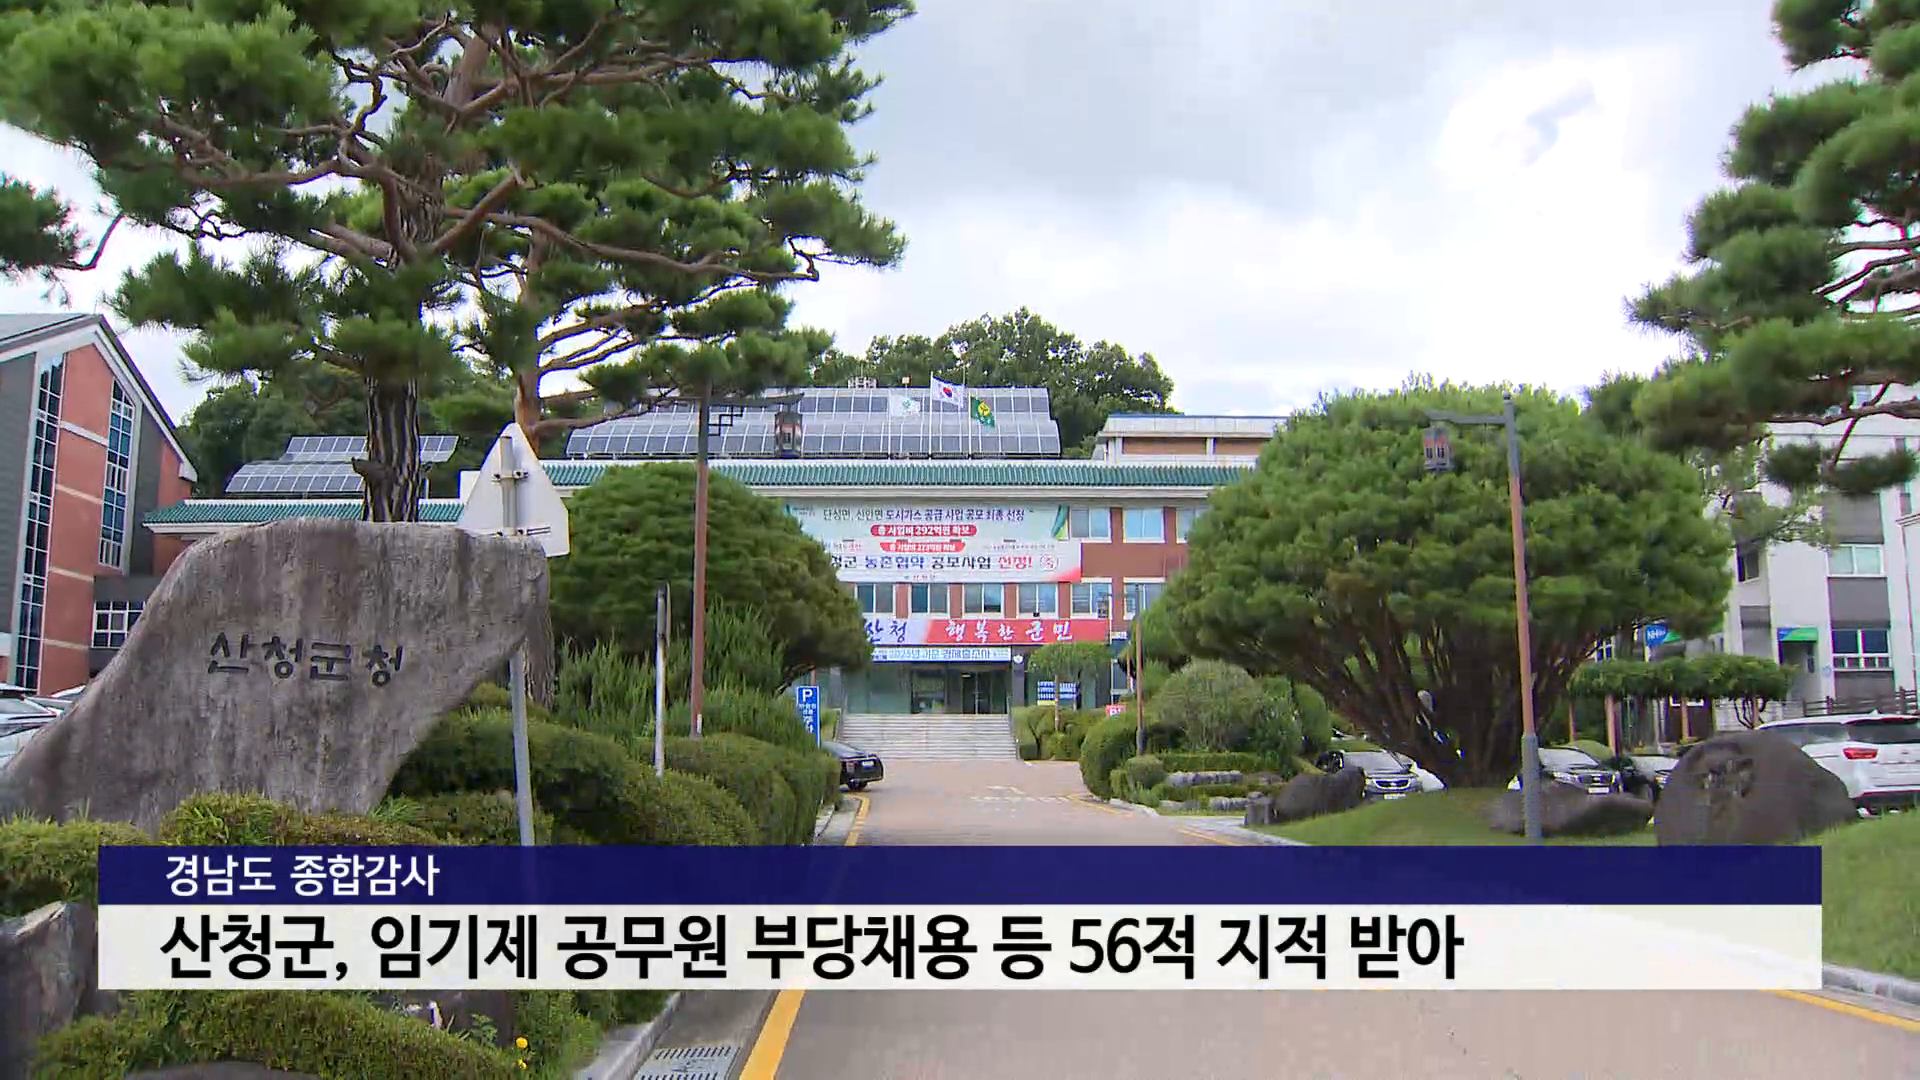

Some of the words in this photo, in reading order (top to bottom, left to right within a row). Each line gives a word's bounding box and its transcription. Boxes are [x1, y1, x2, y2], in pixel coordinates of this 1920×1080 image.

[886, 508, 921, 521] 도시가스
[924, 508, 942, 521] 공급
[945, 508, 963, 521] 사업
[966, 508, 984, 521] 공모
[1007, 508, 1025, 522] 선정
[865, 555, 925, 569] 농촌협약
[931, 556, 991, 570] 공모사업
[998, 556, 1033, 570] 선정!
[865, 619, 907, 643] 산청
[945, 620, 1013, 643] 행복한
[1026, 620, 1073, 642] 군민
[208, 632, 404, 687] 산청군청
[802, 689, 813, 702] P
